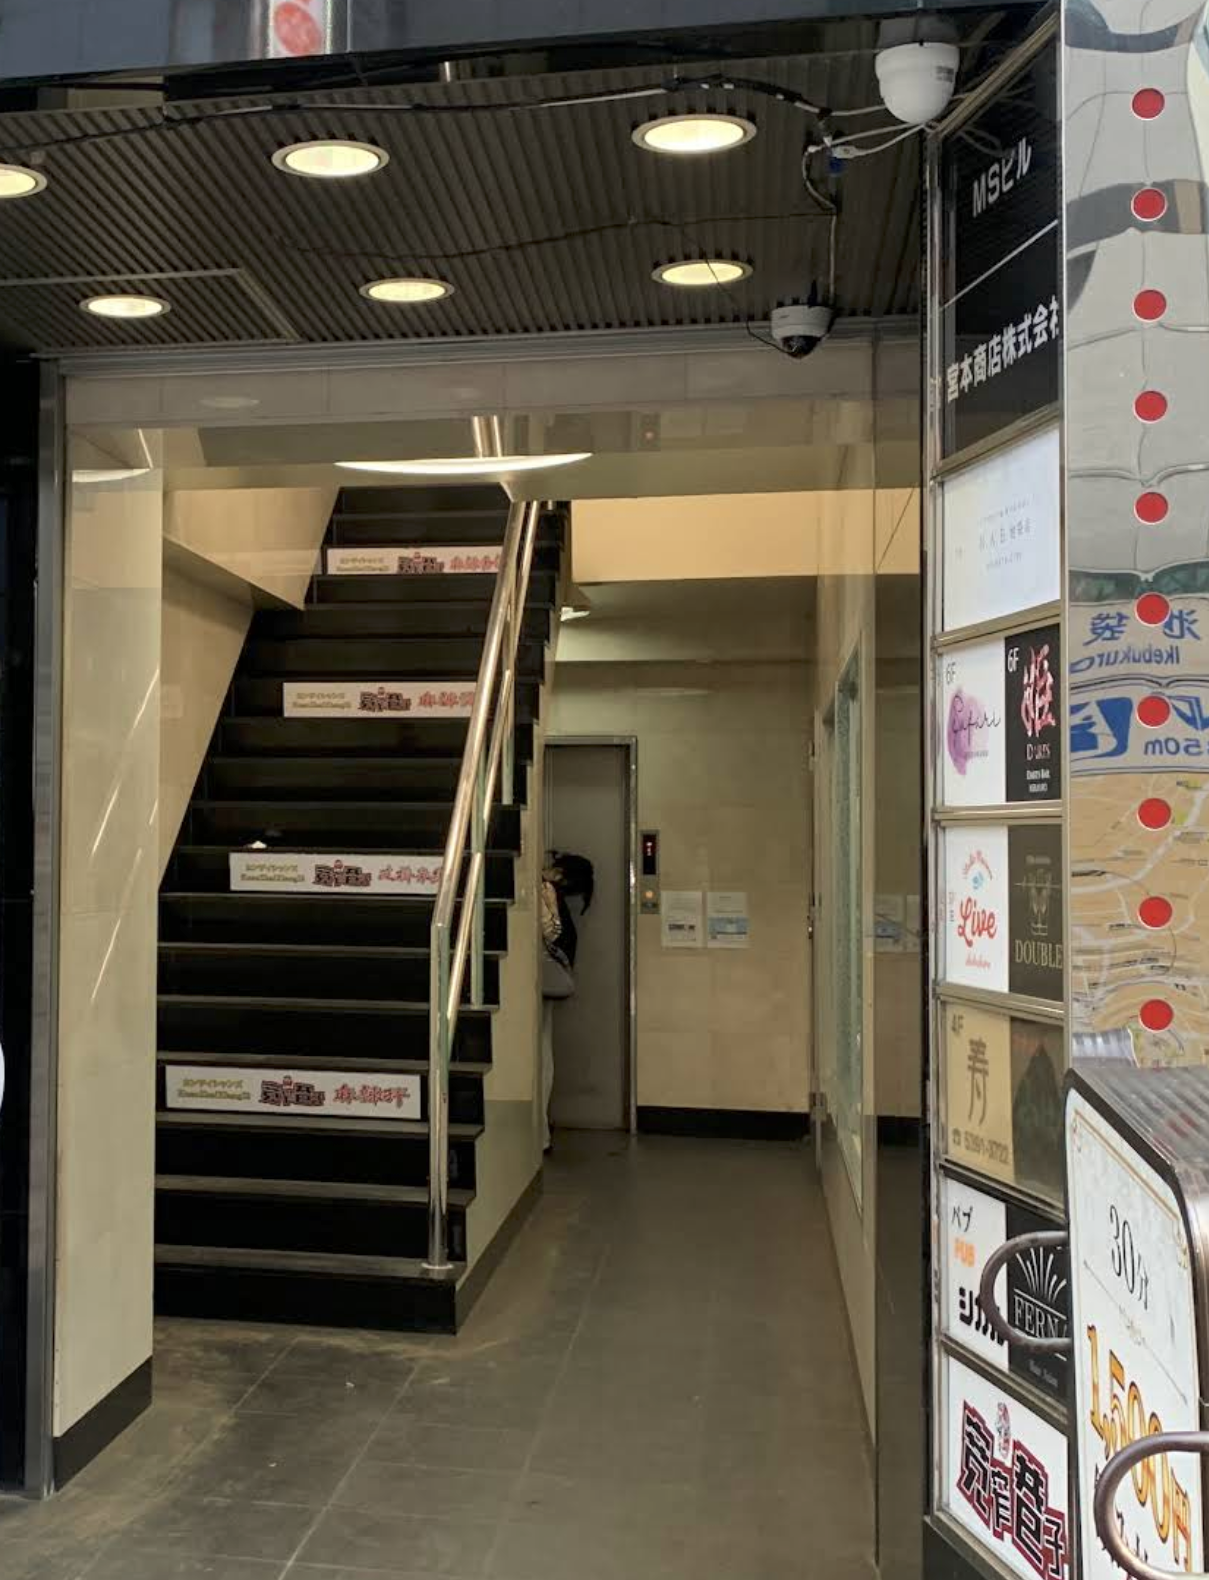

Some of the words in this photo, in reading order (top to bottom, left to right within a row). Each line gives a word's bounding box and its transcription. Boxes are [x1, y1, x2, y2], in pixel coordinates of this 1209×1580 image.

[971, 136, 1032, 219] MSビル
[1007, 648, 1019, 672] 6F
[957, 896, 997, 948] Live
[1014, 939, 1062, 969] DOUBLE
[1013, 1294, 1068, 1338] FERN
